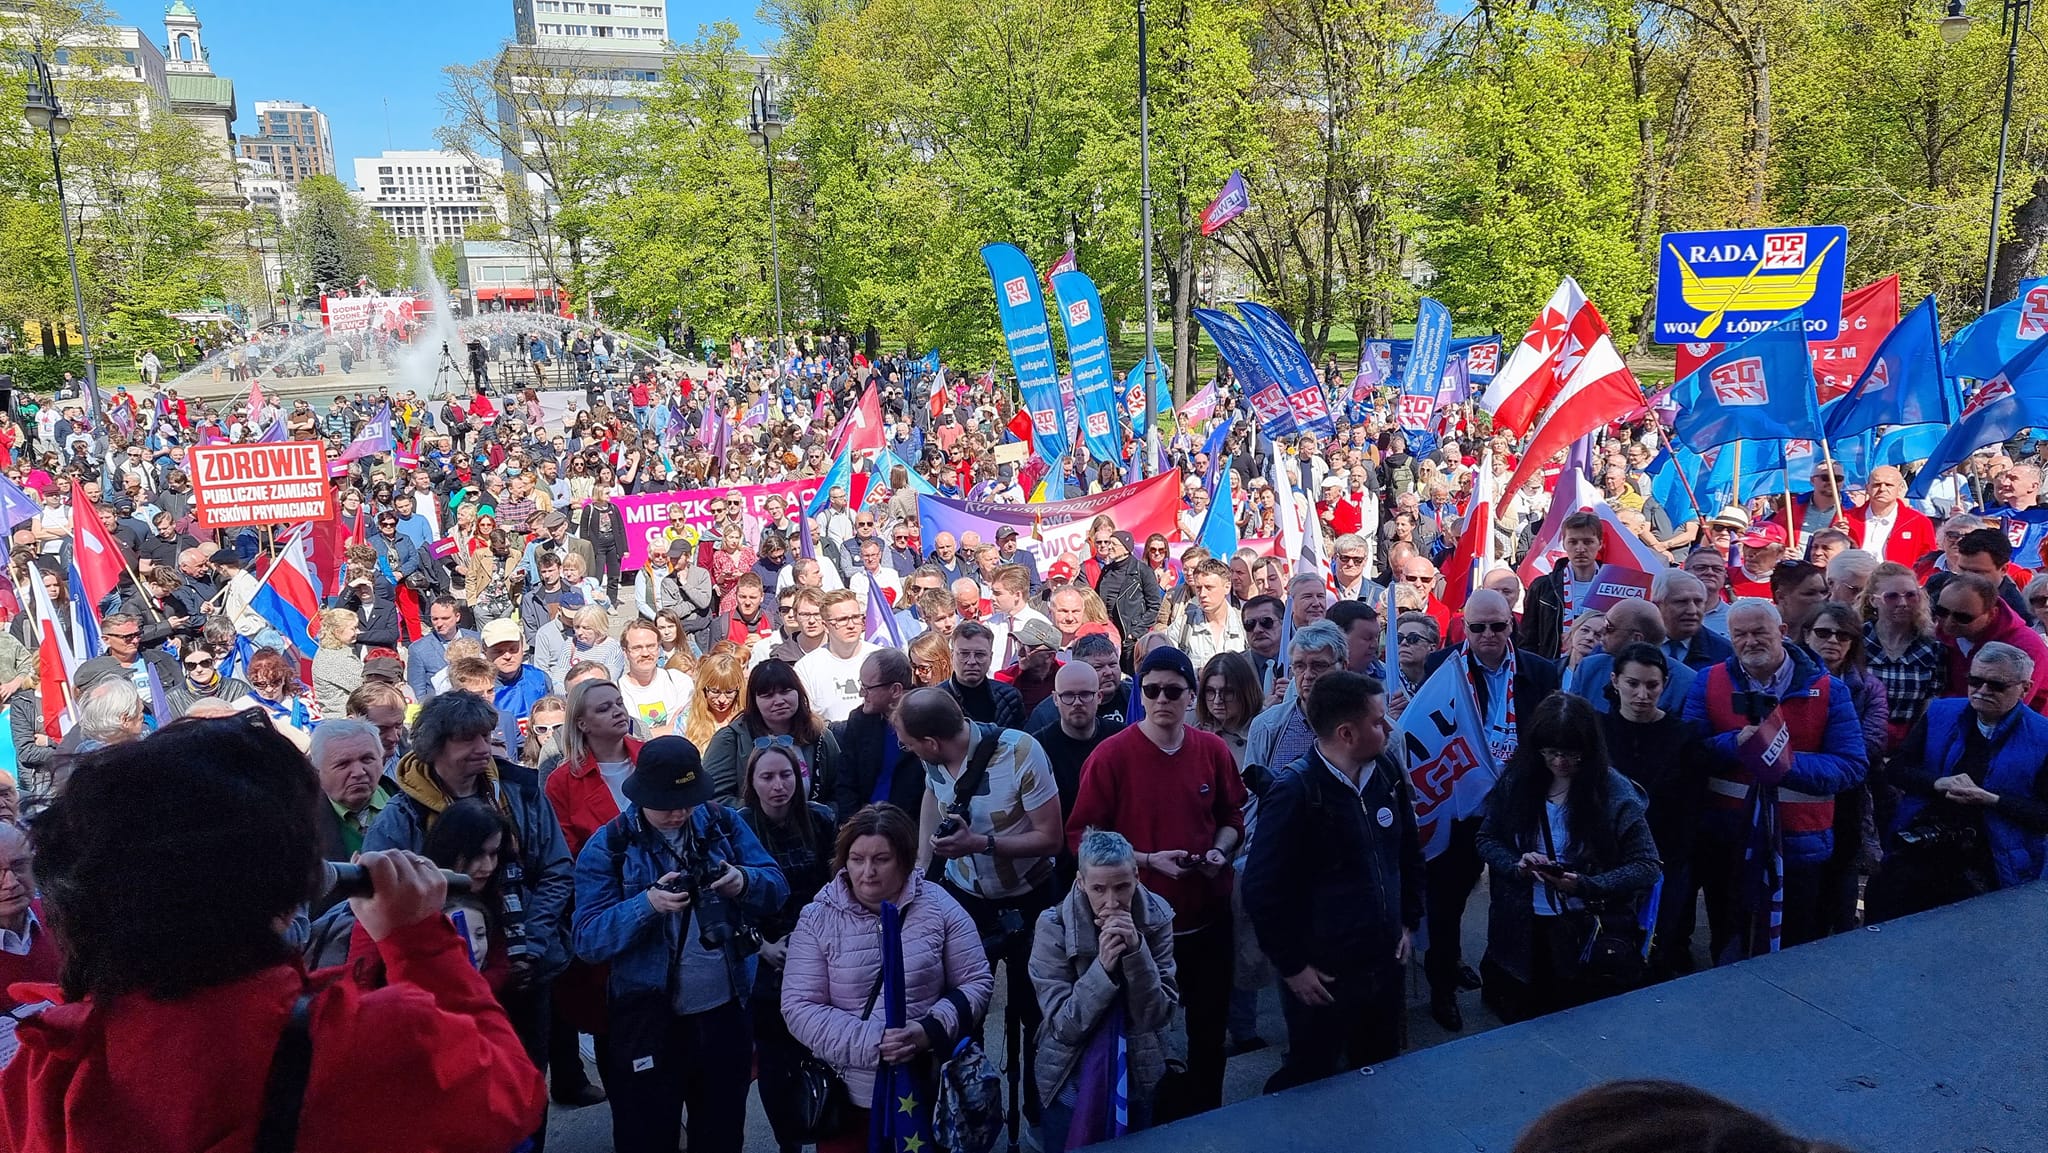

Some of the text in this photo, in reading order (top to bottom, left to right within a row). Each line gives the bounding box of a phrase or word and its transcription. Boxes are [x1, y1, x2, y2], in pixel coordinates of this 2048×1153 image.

[1690, 244, 1758, 263] RADA
[1663, 322, 1698, 336] WOJ
[203, 448, 316, 482] ZDROWIE
[270, 482, 323, 500] ZAMIAST
[206, 501, 325, 524] ZYSKÓW PRYWACIARZY
[1599, 584, 1644, 599] LEWICA
